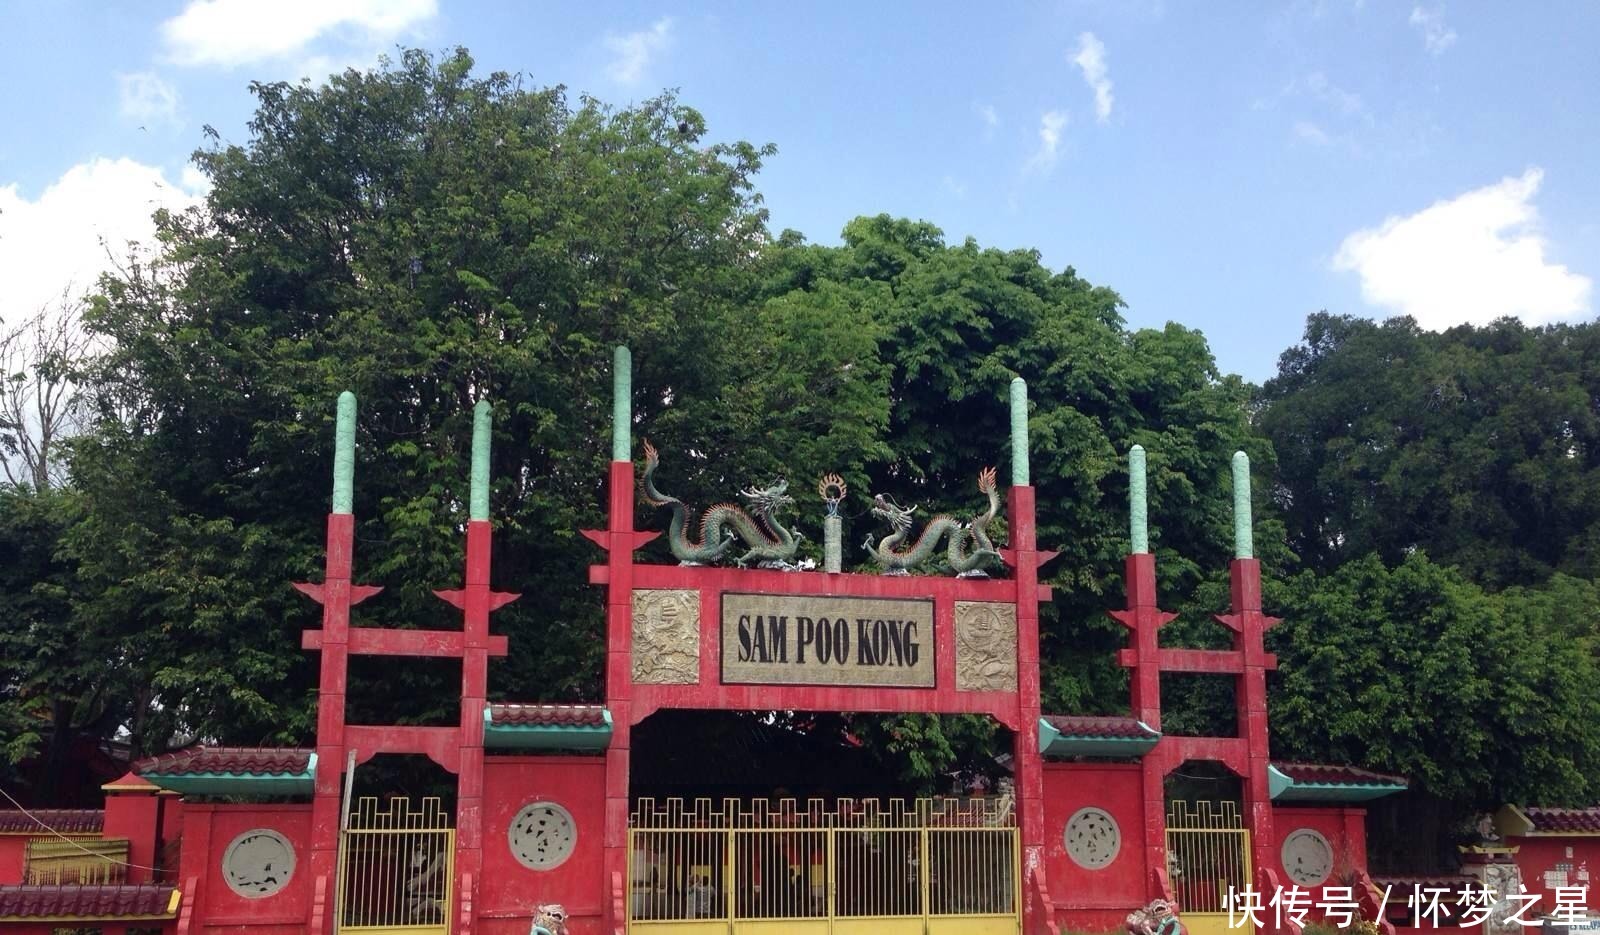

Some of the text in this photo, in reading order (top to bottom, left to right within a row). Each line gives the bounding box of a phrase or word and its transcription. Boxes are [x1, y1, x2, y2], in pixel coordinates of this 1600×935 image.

[738, 614, 920, 667] SAM POO KONG
